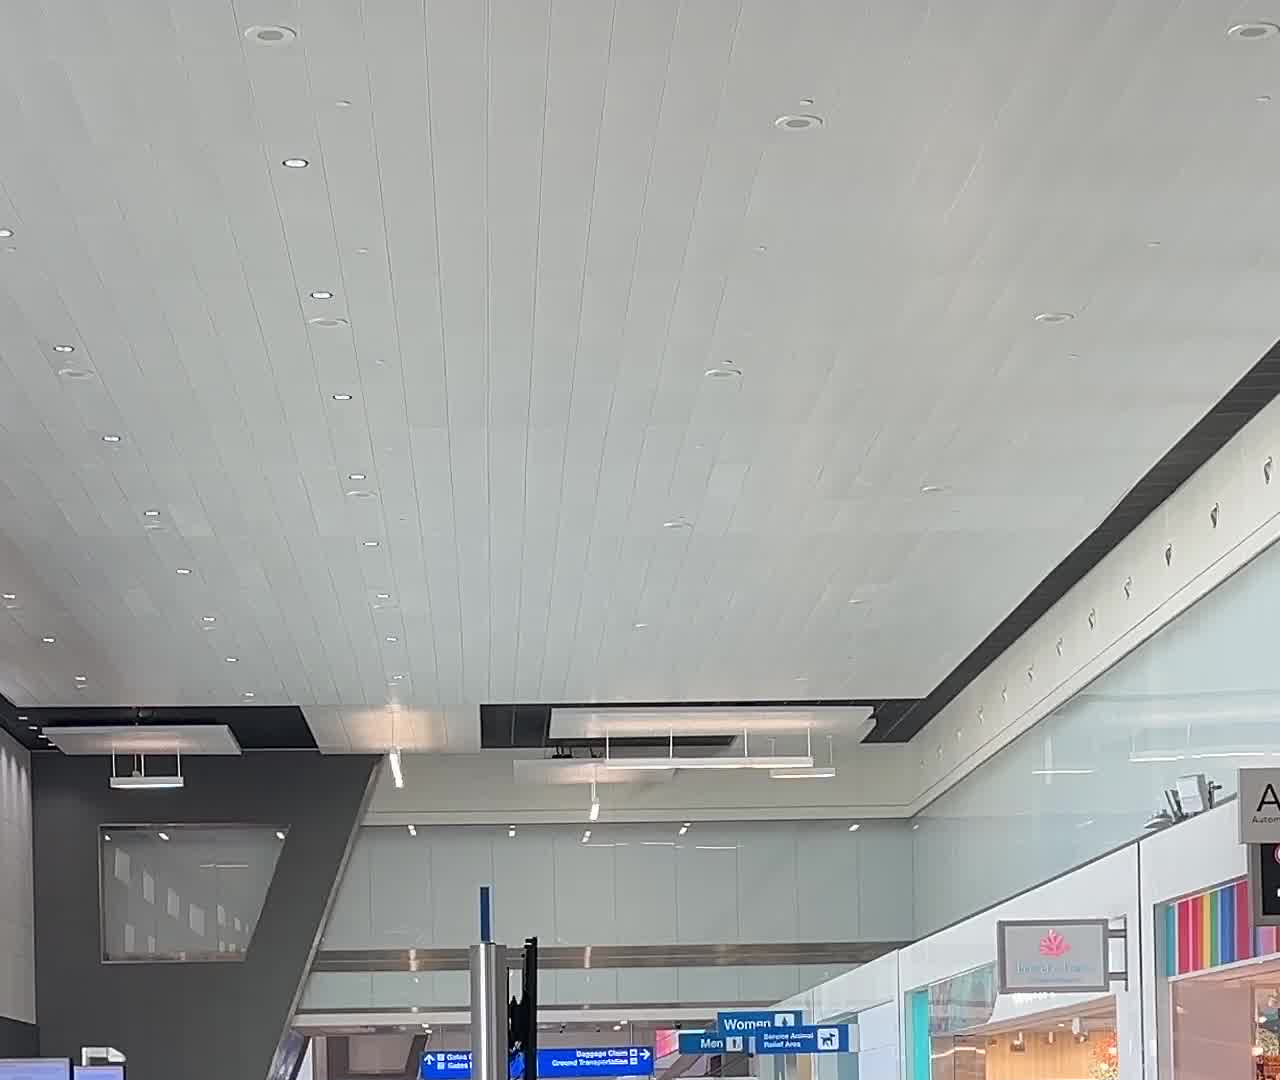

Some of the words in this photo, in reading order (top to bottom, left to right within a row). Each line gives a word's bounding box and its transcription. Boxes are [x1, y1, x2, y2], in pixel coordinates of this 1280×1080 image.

[723, 1018, 770, 1031] Women
[790, 1032, 814, 1040] Animal
[700, 1038, 724, 1049] Men
[447, 1053, 467, 1061] Gates
[576, 1050, 606, 1058] Baggage
[608, 1049, 628, 1057] Claim
[552, 1059, 577, 1067] Ground
[579, 1058, 628, 1067] Transportation
